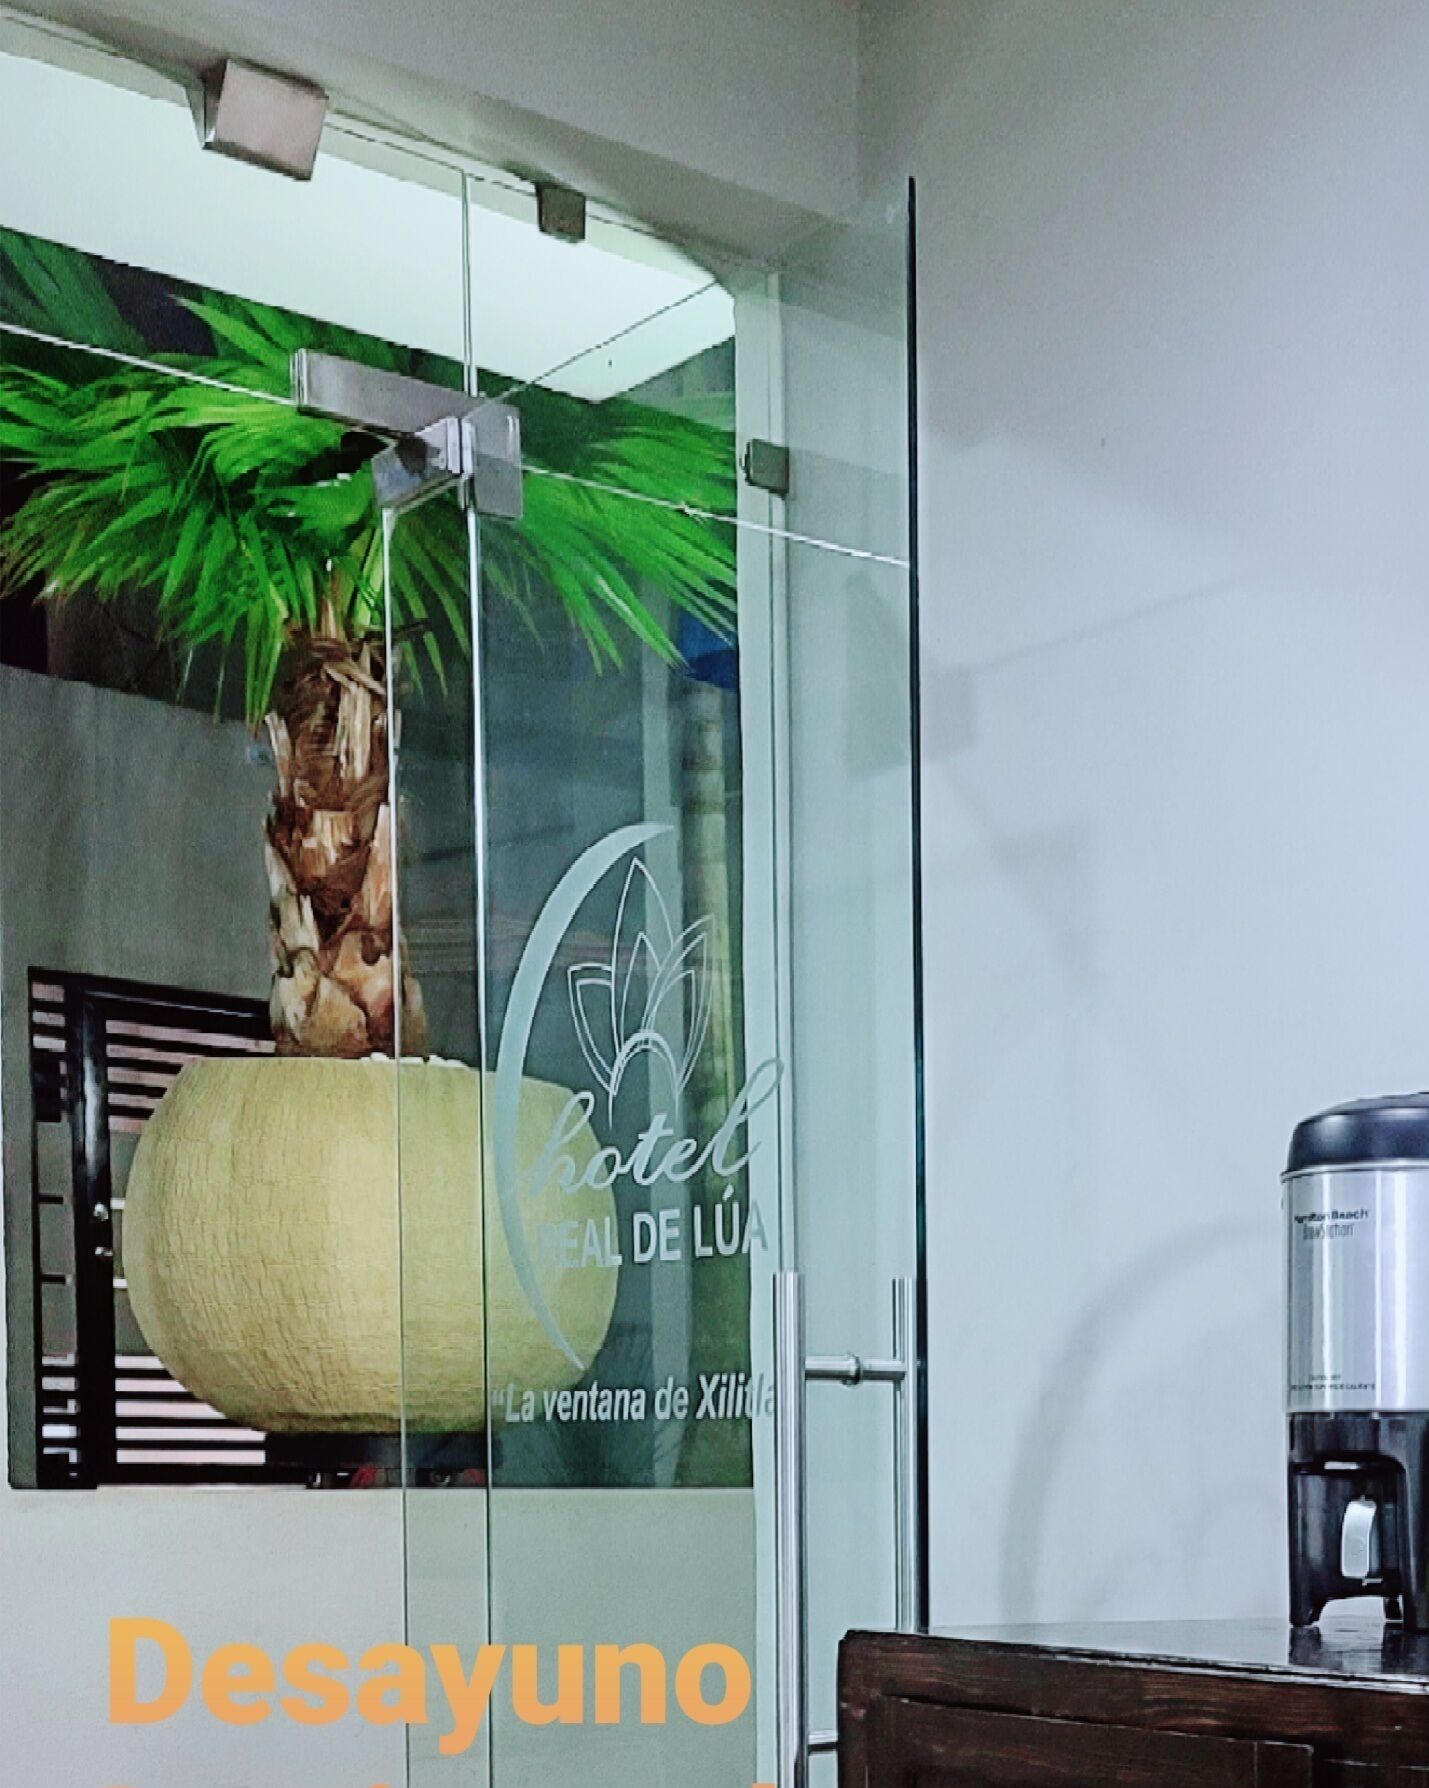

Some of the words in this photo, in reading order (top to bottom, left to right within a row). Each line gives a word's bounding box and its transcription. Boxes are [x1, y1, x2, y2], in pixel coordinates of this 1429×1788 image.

[526, 1056, 785, 1196] hotel
[632, 1208, 682, 1264] DE
[693, 1182, 769, 1259] LÚA
[543, 1380, 646, 1422] ventana
[653, 1375, 689, 1420] de
